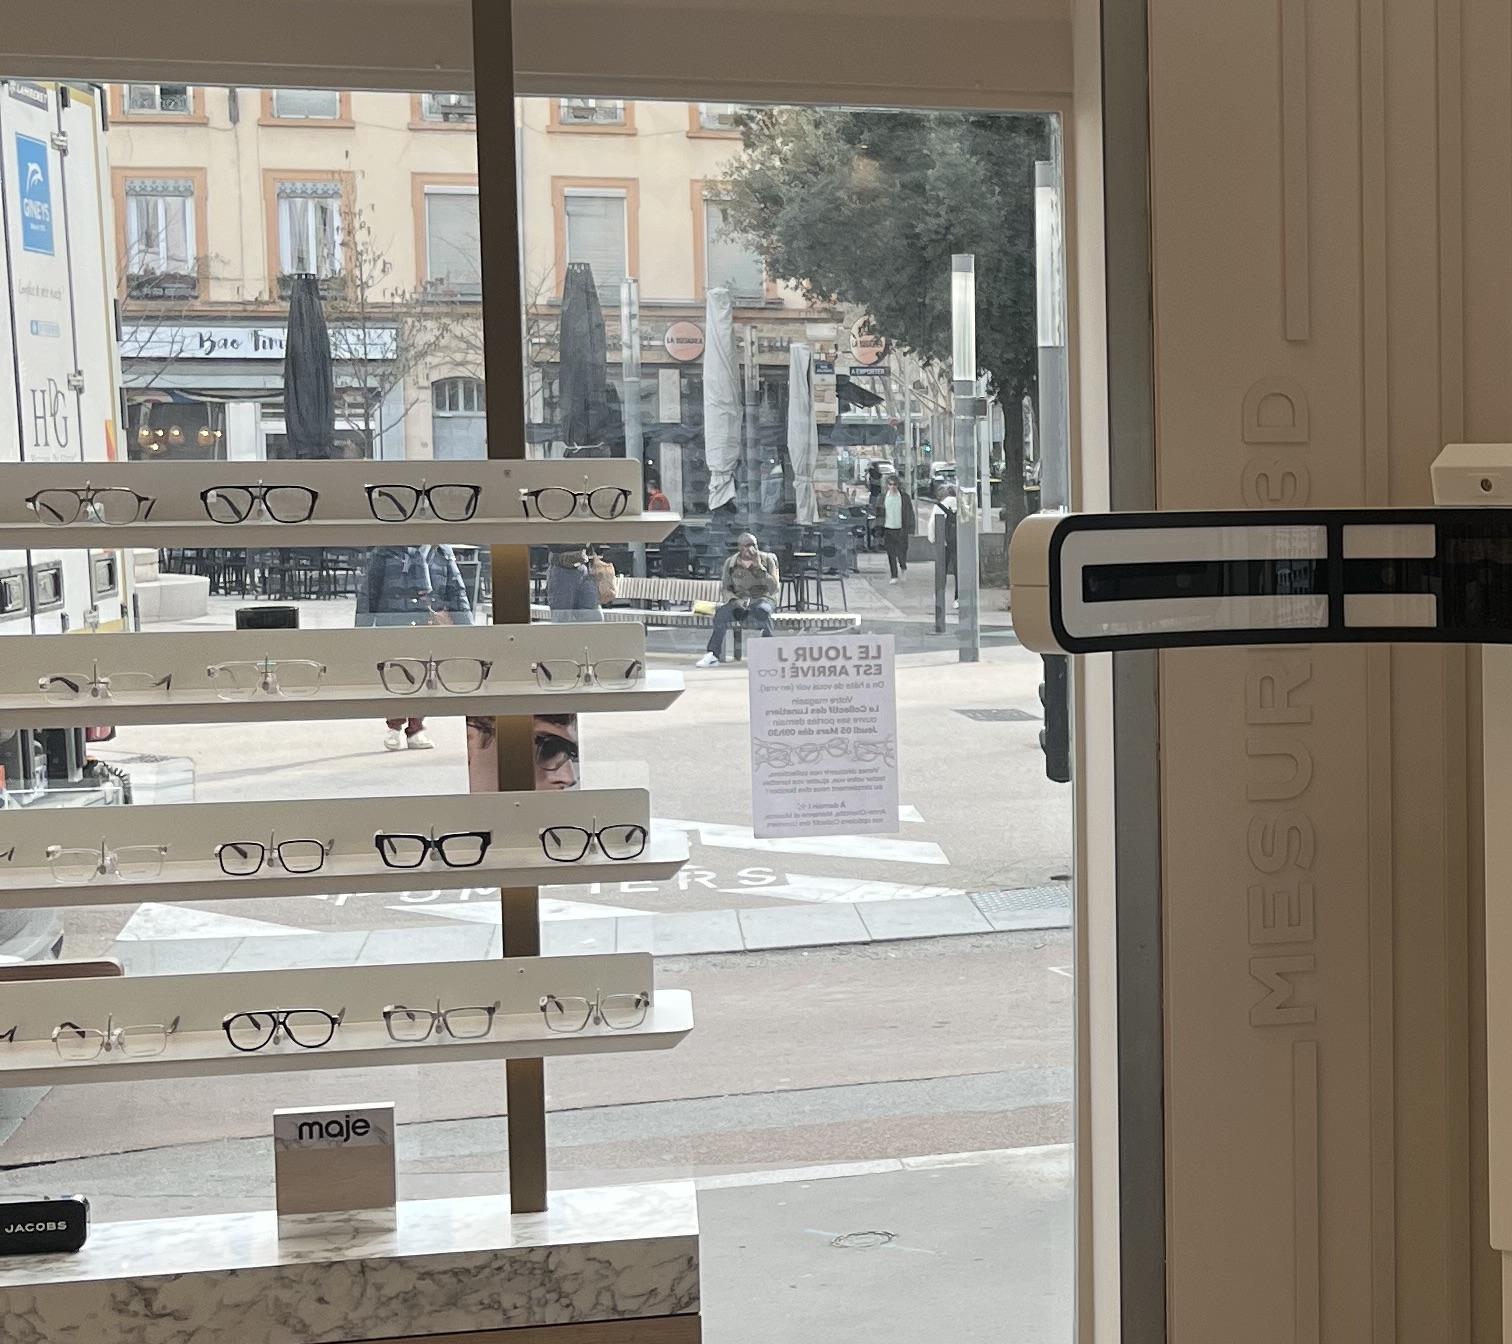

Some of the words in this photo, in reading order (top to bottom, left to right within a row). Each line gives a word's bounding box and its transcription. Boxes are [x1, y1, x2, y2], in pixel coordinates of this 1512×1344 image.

[1244, 646, 1318, 1030] MESUR
[298, 1114, 371, 1143] maje
[4, 1221, 67, 1234] JACOBS
